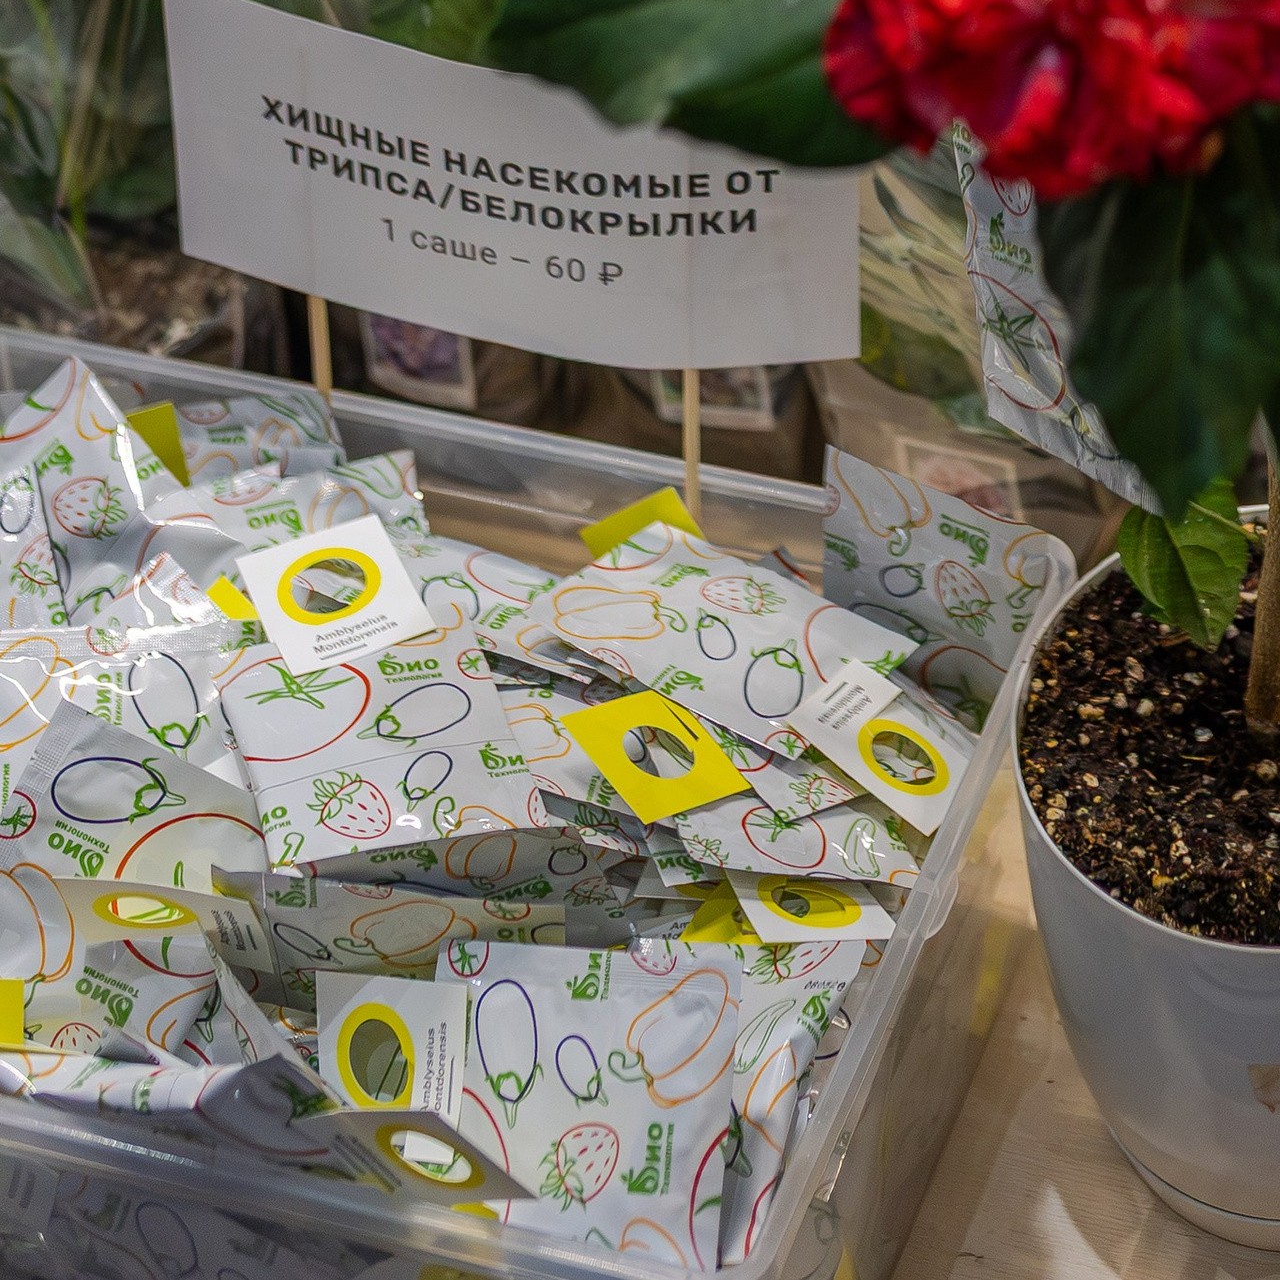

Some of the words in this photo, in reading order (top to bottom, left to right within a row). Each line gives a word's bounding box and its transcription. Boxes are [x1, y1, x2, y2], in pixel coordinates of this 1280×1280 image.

[261, 94, 432, 167] ХИЩНЫЕ
[443, 147, 711, 199] НАСЕКОМЫЕ
[725, 168, 781, 196] ОТ
[283, 138, 759, 238] ТРИПСА/БЕЛОКРЫЛКИ
[379, 217, 396, 242] 1
[410, 229, 499, 266] саше
[545, 255, 587, 283] 60
[598, 262, 624, 286] ₽
[377, 652, 440, 676] Био
[478, 741, 524, 770] Би
[487, 766, 530, 779] Техноло
[47, 831, 105, 878] Био
[55, 819, 110, 854] Технология
[657, 856, 705, 881] Би
[82, 965, 141, 998] Технология
[566, 952, 602, 1001] Би
[75, 976, 135, 1029] Био
[433, 1021, 448, 1116] ontdorensis
[620, 1122, 664, 1196] Био
